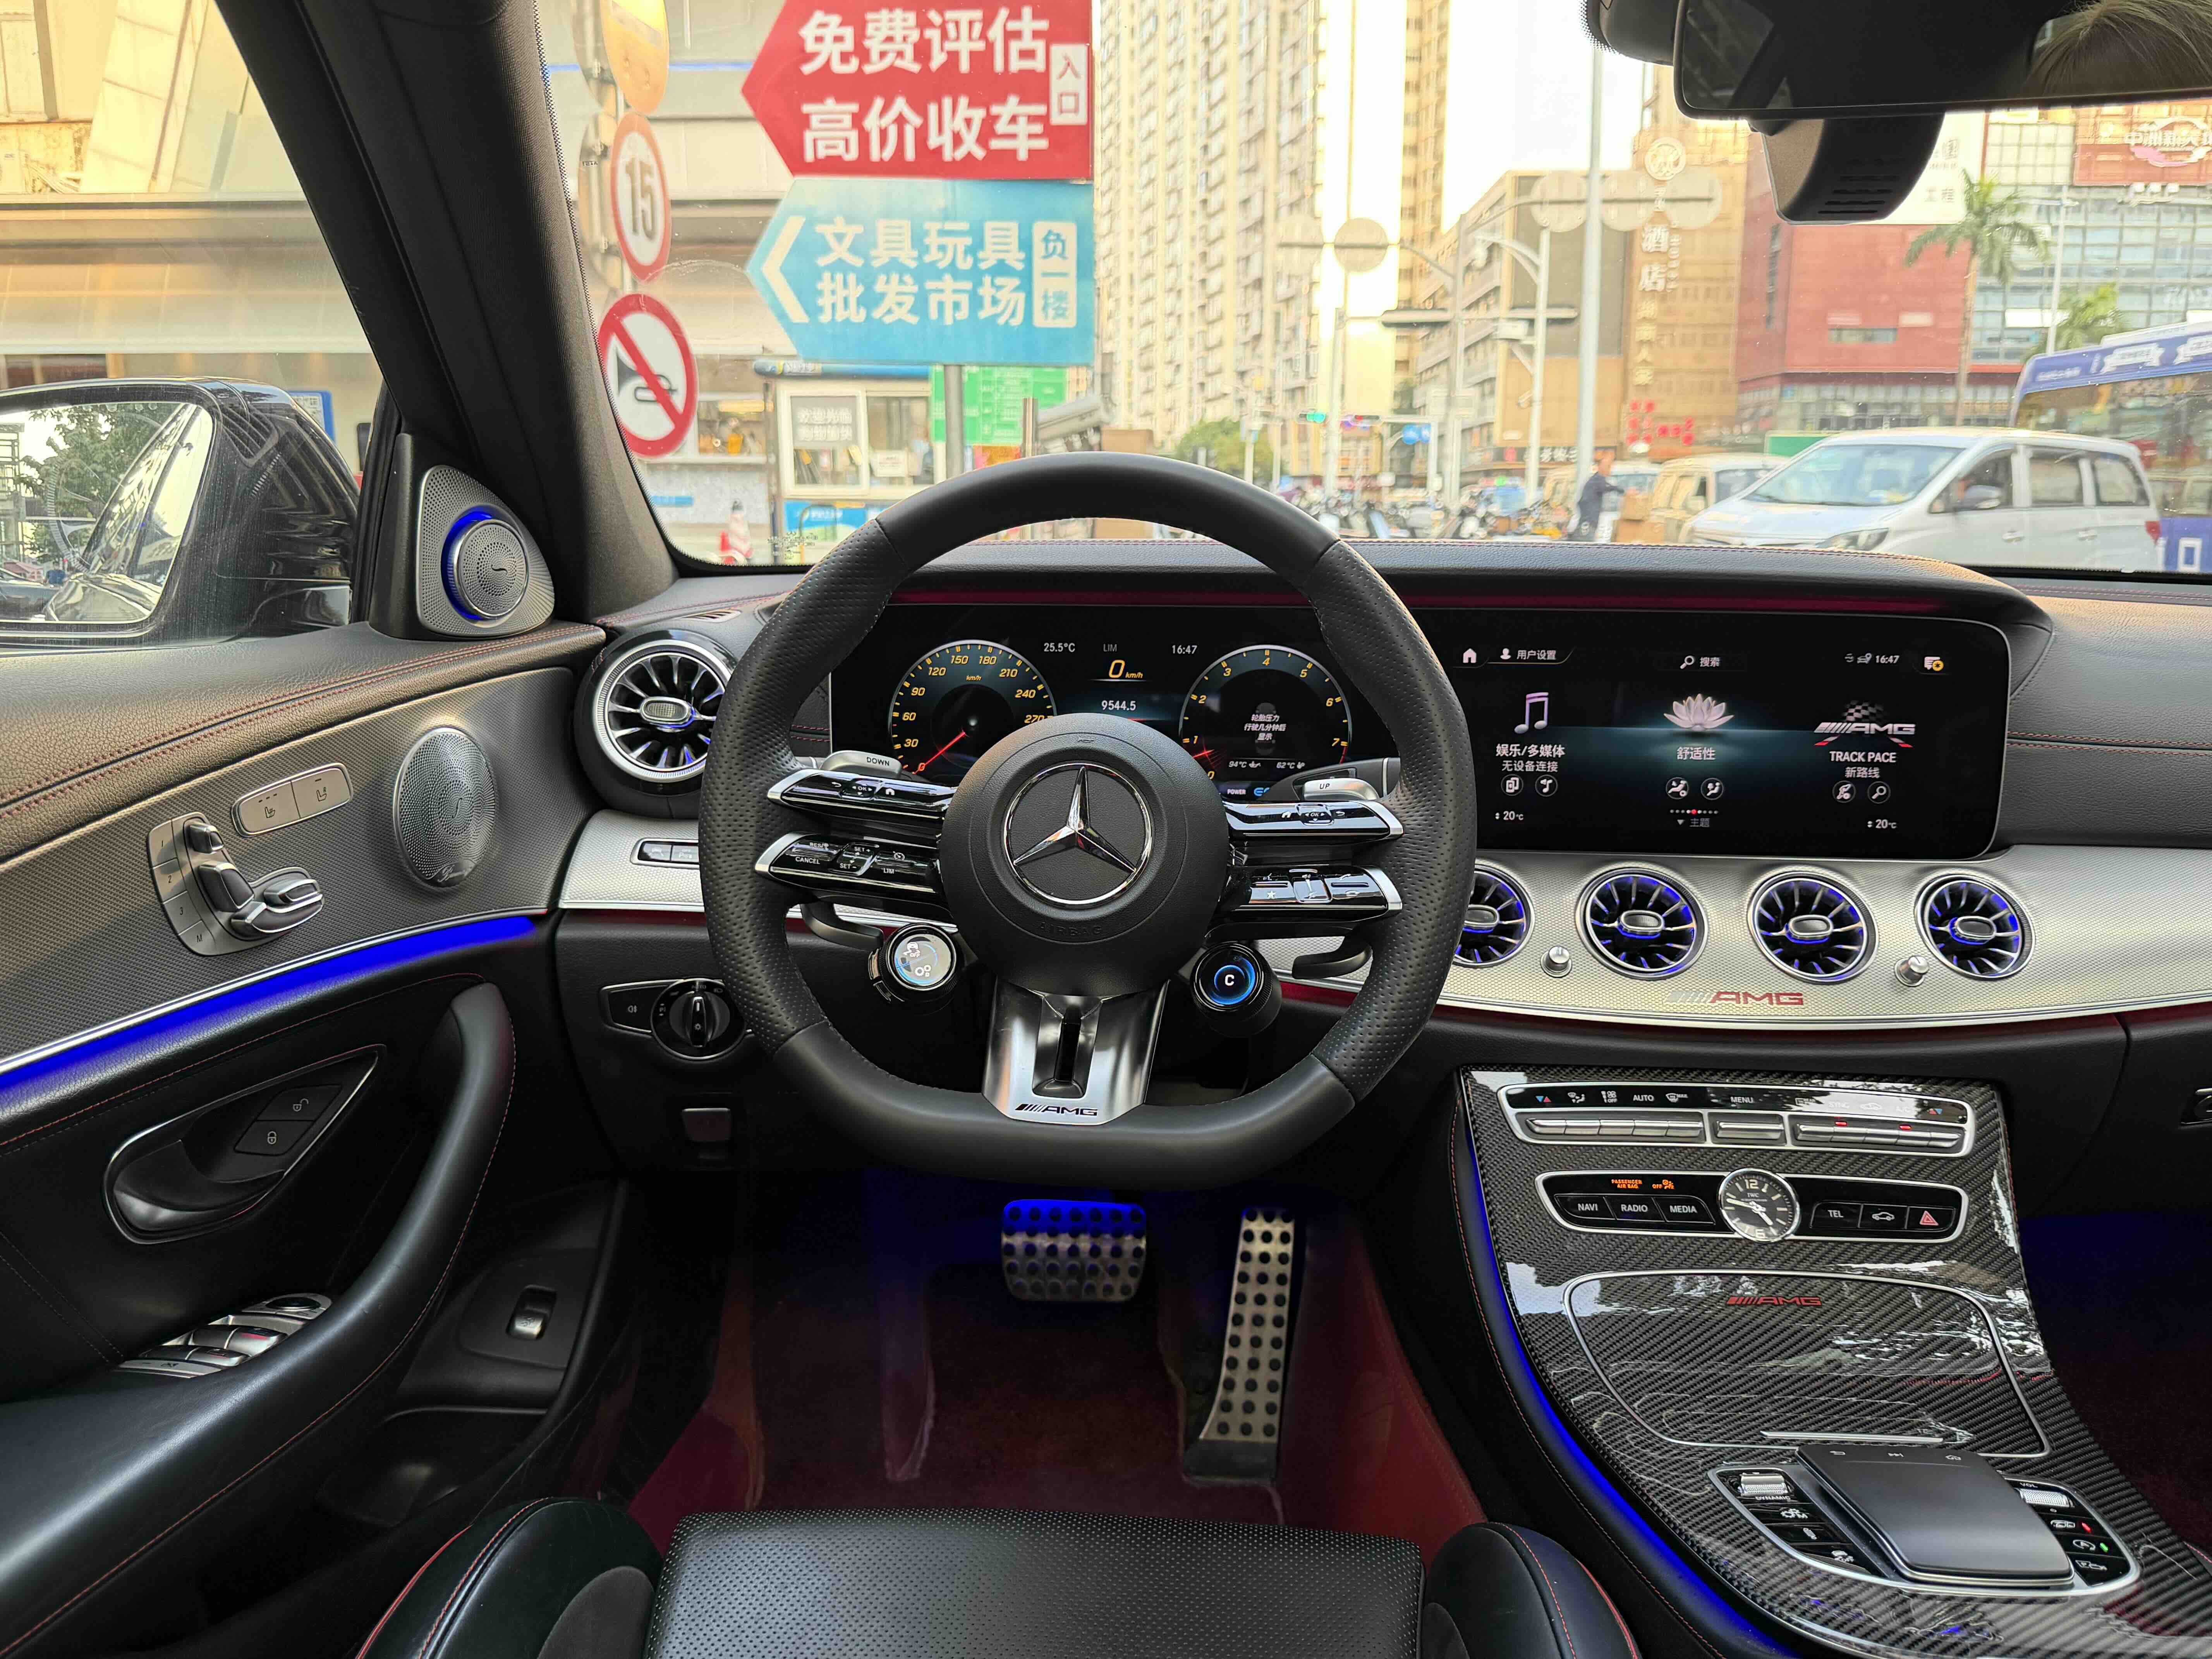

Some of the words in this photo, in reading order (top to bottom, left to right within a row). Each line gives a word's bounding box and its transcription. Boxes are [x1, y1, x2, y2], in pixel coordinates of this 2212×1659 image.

[800, 7, 1049, 75] 免费评估
[1058, 54, 1081, 115] 入口
[802, 98, 1049, 162] 高价收车
[625, 159, 656, 238] 15
[816, 218, 1025, 270] 文具玩具
[1041, 230, 1072, 321] 负一楼
[817, 275, 1025, 325] 批发市场
[1044, 643, 1075, 652] 25.5°C
[1172, 645, 1197, 654] 16:47
[951, 656, 969, 664] 150
[1517, 650, 1557, 661] 用户设置
[1875, 655, 1899, 664] 16:47
[979, 656, 996, 665] 180
[1262, 658, 1270, 666] 4
[1700, 657, 1720, 667] 搜索
[928, 667, 946, 676] 120
[999, 669, 1018, 677] 210
[1109, 660, 1125, 678] 0
[1224, 668, 1231, 677] 3
[911, 687, 925, 696] 90
[1015, 690, 1036, 698] 240
[1102, 701, 1136, 711] 9544.5
[902, 713, 916, 721] 60
[1025, 715, 1044, 724] 270
[1849, 724, 1915, 734] AMG
[904, 739, 919, 747] 30
[1496, 744, 1565, 757] 娱乐/多媒体
[1676, 747, 1716, 760] 舒适性
[866, 757, 890, 766] DOWN
[1830, 752, 1865, 762] TRACK
[1868, 752, 1896, 763] PACE
[918, 763, 925, 771] 0
[1502, 761, 1558, 772] 无设备连接
[1845, 767, 1879, 778] 新路线
[1690, 818, 1710, 827] 主题
[168, 875, 172, 883] 2
[1225, 974, 1235, 986] C
[1710, 991, 1803, 1005] AMG
[1042, 1106, 1098, 1116] AMG
[1745, 1179, 1760, 1189] 12
[1578, 1204, 1598, 1212] NAVI
[1621, 1204, 1648, 1213] RADIO
[1670, 1205, 1697, 1214] MEDIA
[1828, 1210, 1843, 1218] TEL
[1755, 1229, 1765, 1238] 6
[1757, 1297, 1821, 1305] AMG
